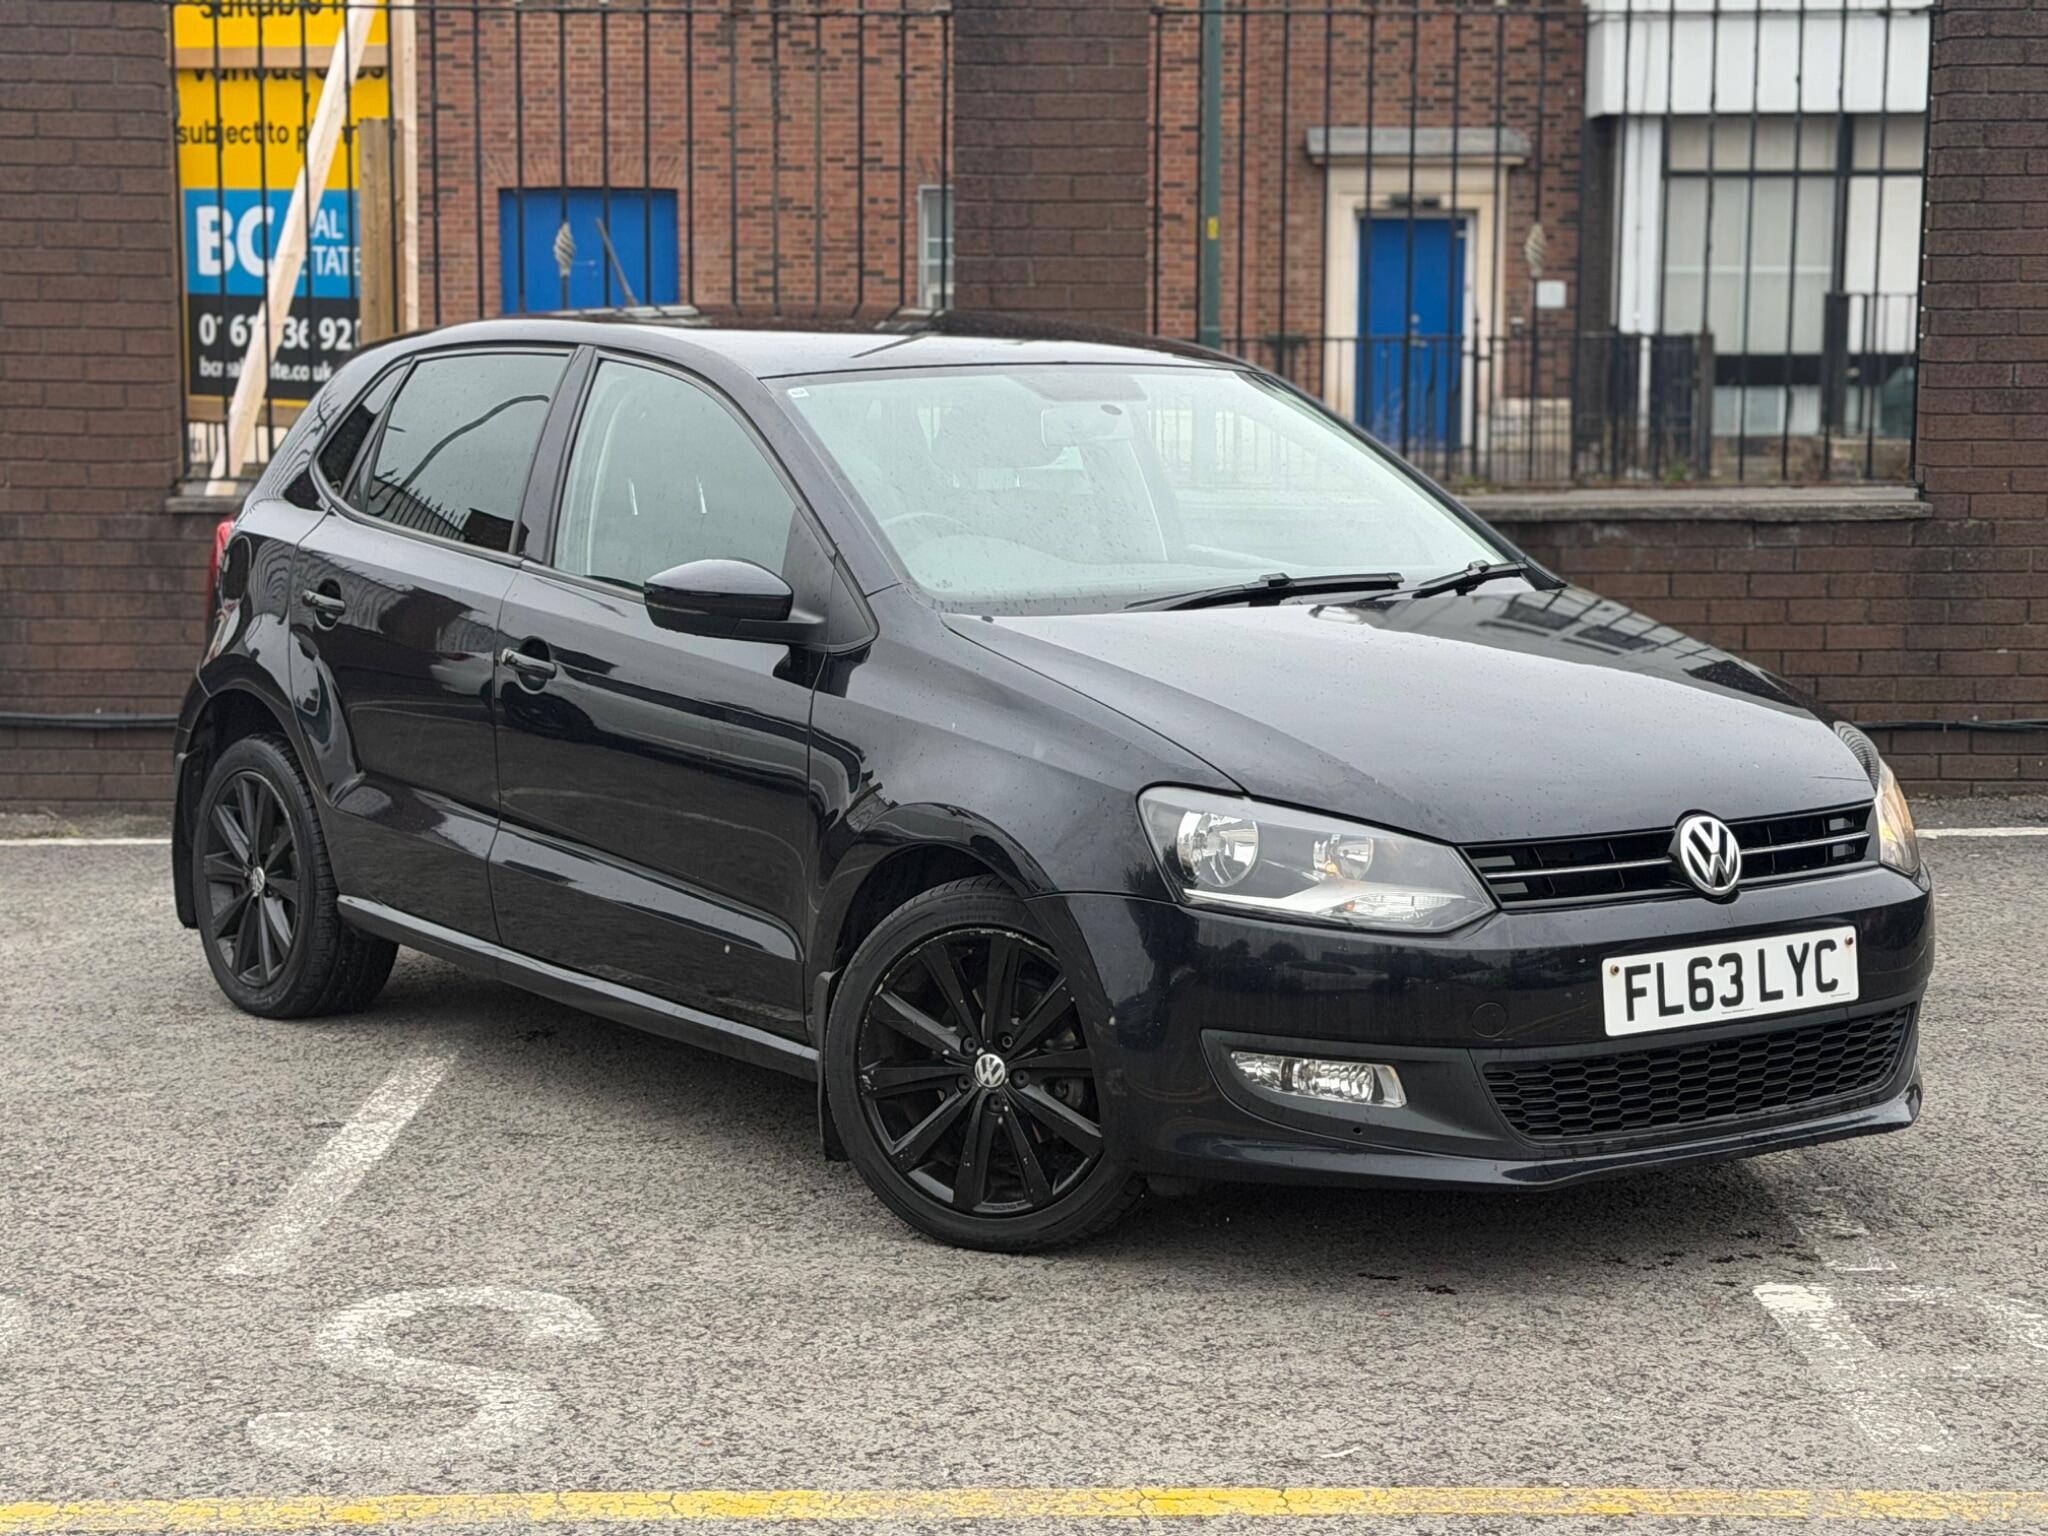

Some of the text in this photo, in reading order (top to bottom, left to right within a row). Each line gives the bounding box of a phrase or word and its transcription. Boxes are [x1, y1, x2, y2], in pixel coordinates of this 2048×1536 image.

[268, 122, 289, 145] to
[1624, 938, 1840, 1023] FL63 LYC
